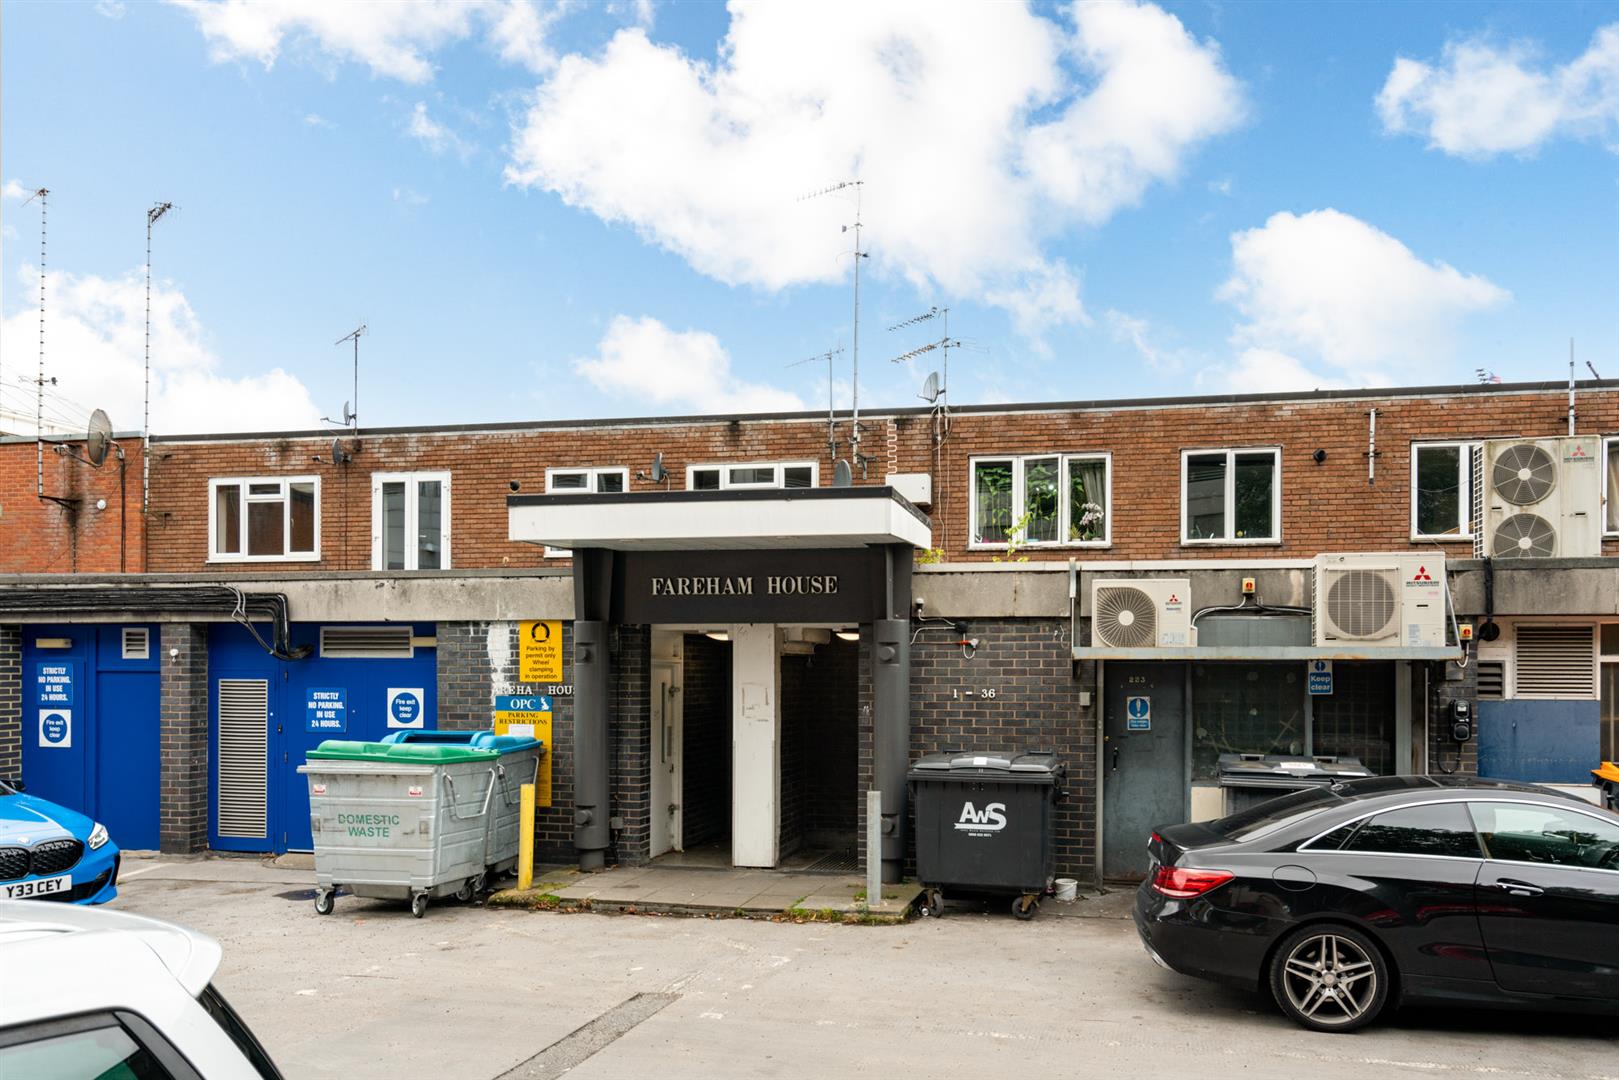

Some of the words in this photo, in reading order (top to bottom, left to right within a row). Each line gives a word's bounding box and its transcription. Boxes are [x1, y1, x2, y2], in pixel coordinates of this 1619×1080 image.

[651, 577, 753, 596] FAREHAM
[767, 575, 838, 594] HOUSE
[1310, 675, 1330, 683] Keep
[548, 686, 575, 694] HOU
[953, 688, 958, 698] 1
[981, 688, 996, 698] 36
[510, 699, 536, 710] OPC
[338, 814, 400, 826] DOMESTIC
[348, 827, 390, 838] WASTE
[6, 883, 34, 898] Y33
[37, 879, 62, 894] CEY
